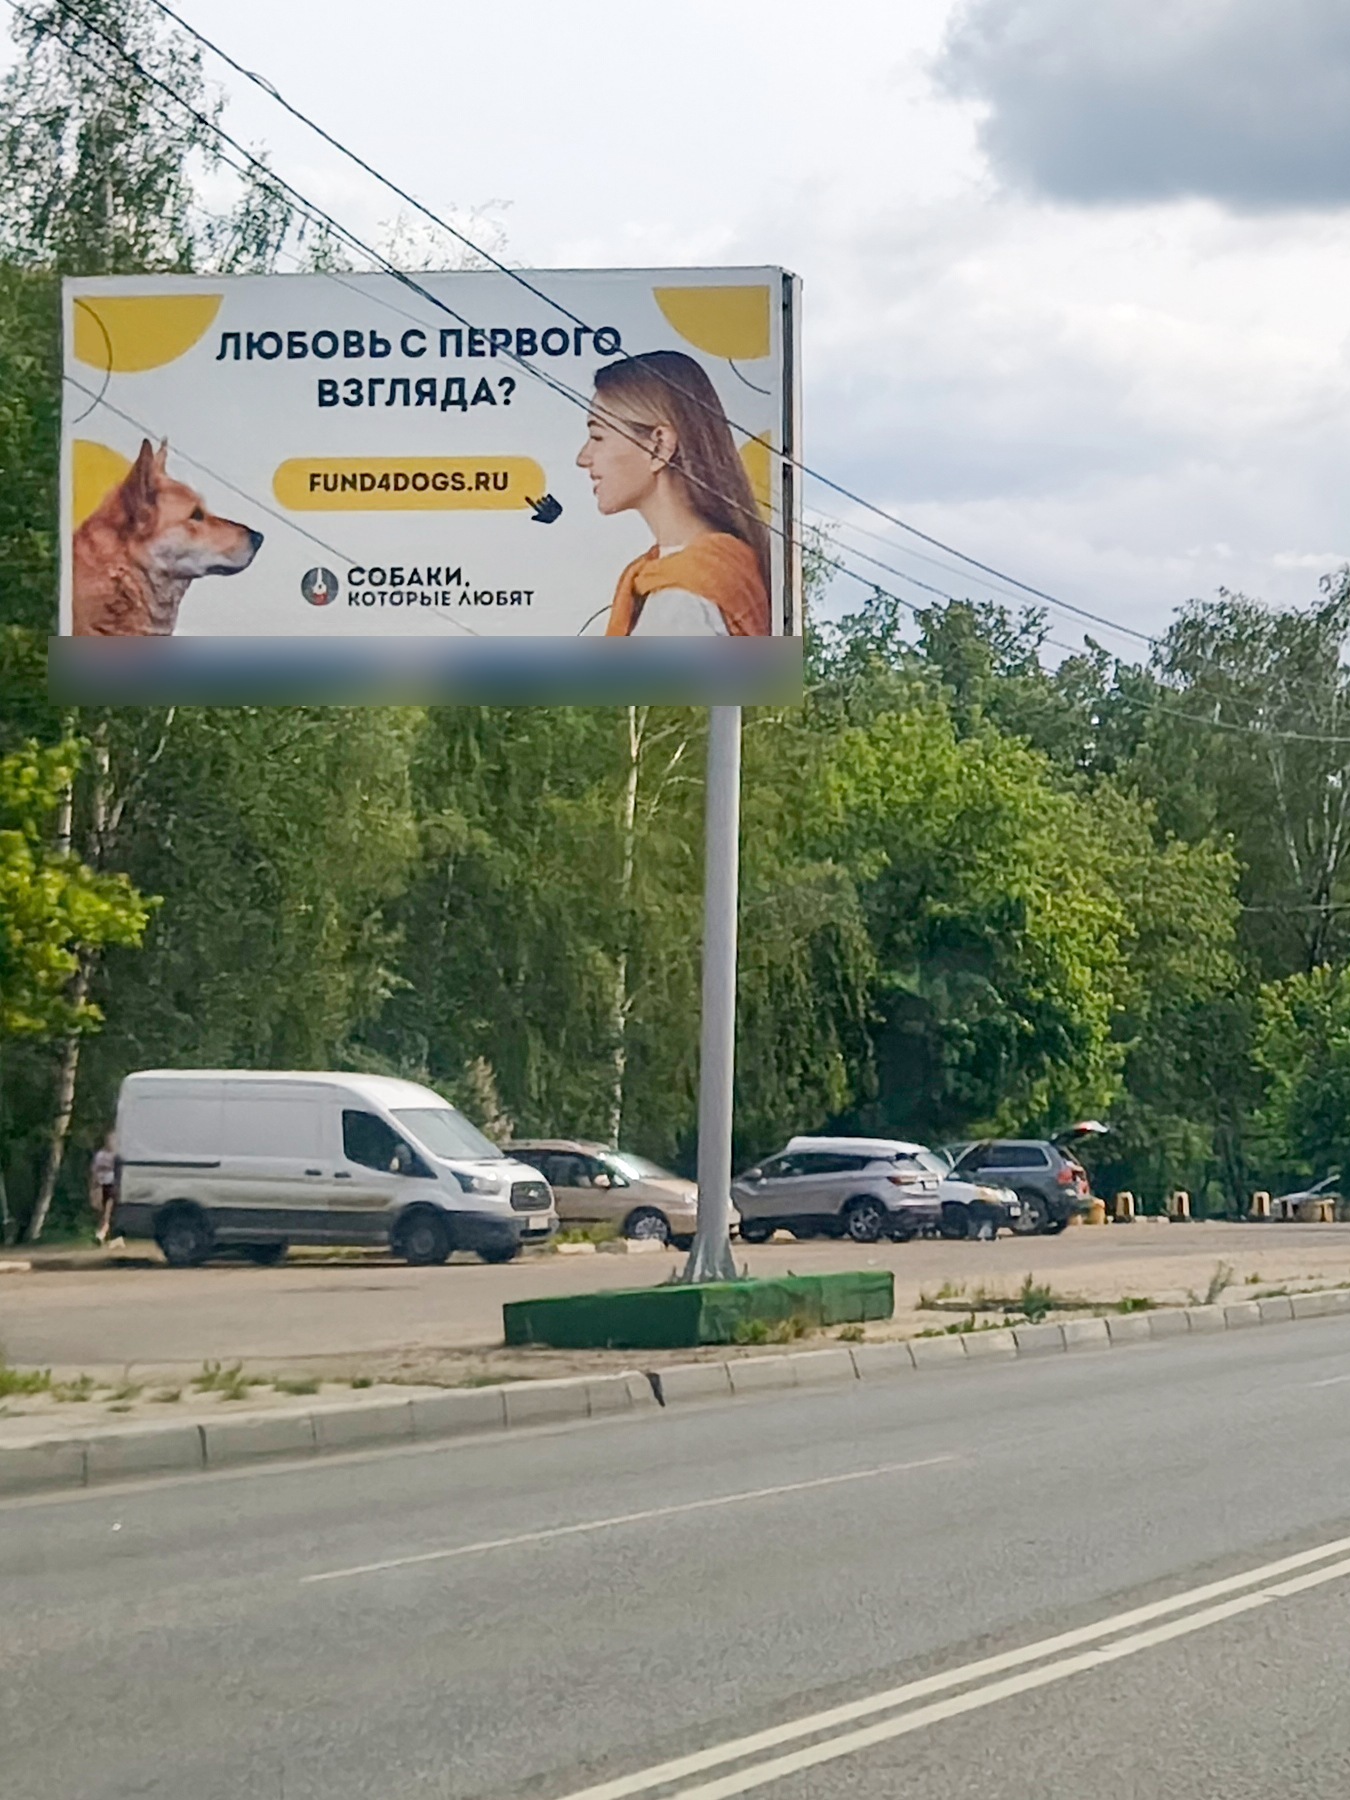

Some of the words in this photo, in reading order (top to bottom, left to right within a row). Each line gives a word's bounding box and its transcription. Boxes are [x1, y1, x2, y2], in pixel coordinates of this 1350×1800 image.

[216, 329, 392, 360] ЛЮБОВЬ
[400, 328, 427, 358] С
[439, 326, 622, 358] ПЕРВОГО
[317, 377, 516, 412] ВЗГЛЯДА?
[309, 471, 509, 492] FUND4DOGS.RU
[348, 590, 451, 607] КОТОРЫЕ
[458, 590, 535, 607] ЛЮБЯТ
